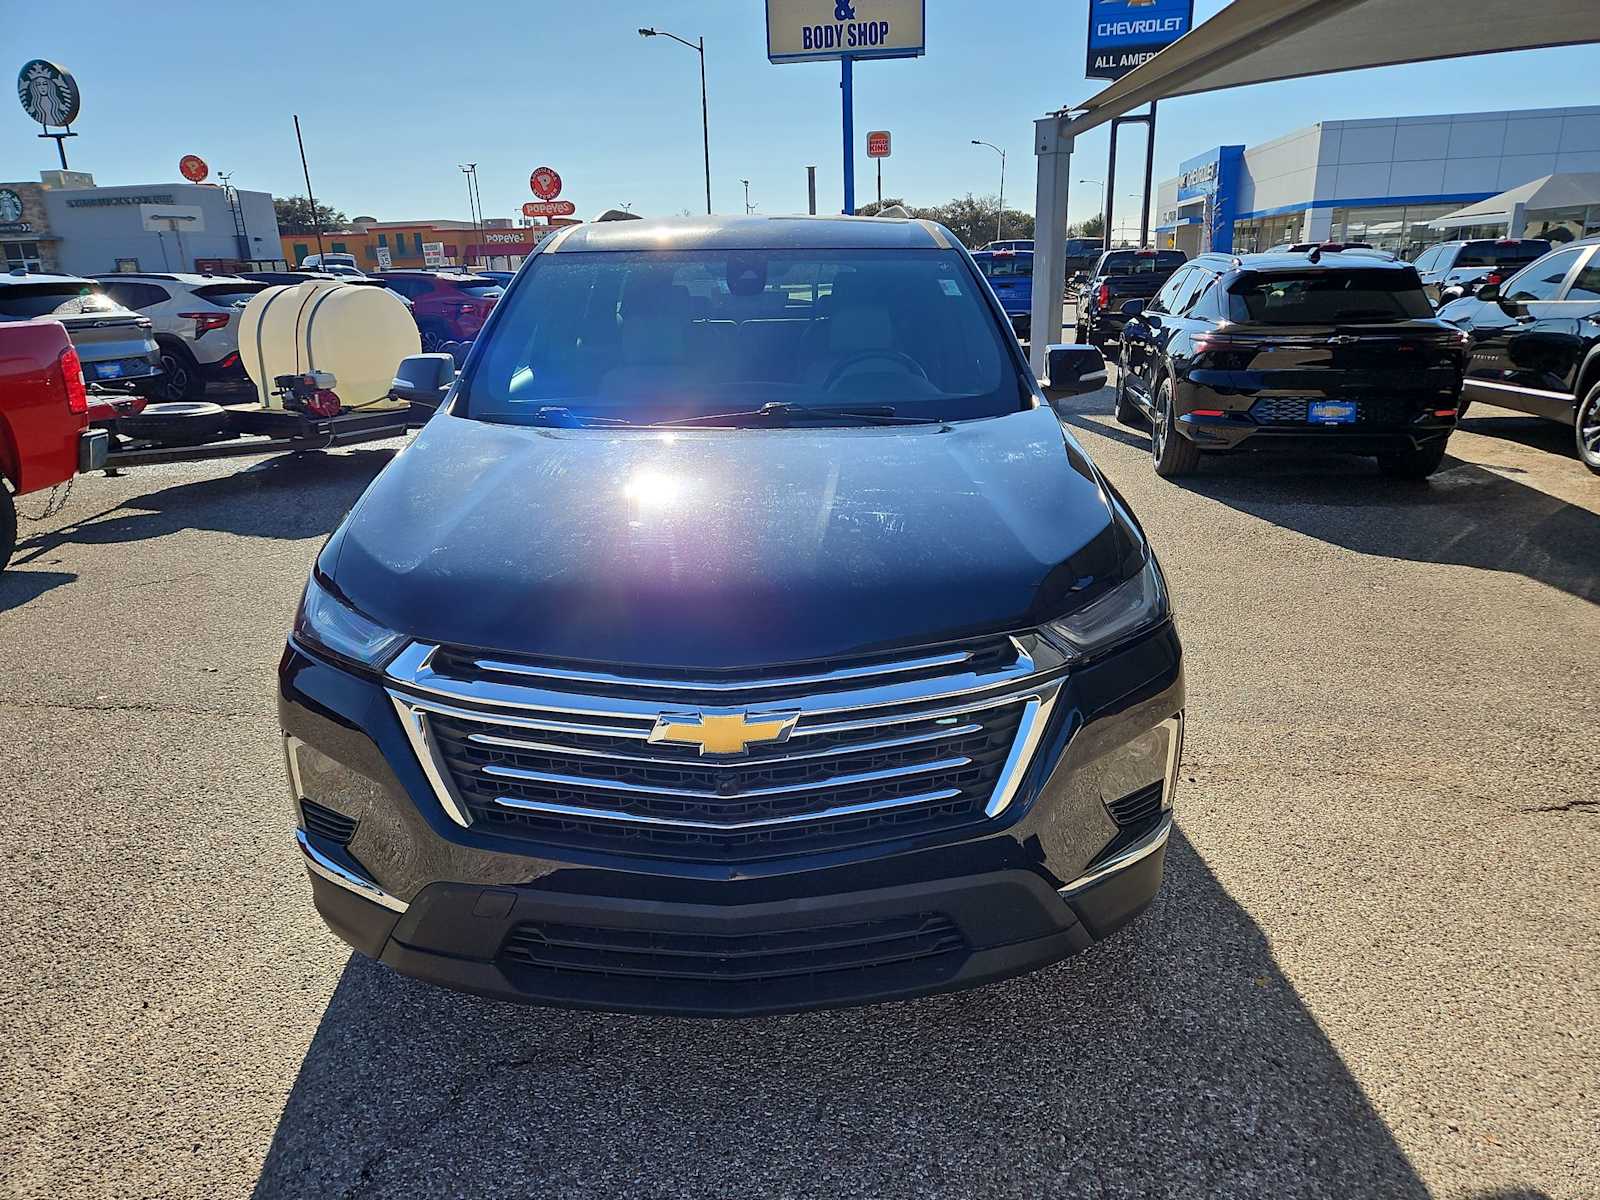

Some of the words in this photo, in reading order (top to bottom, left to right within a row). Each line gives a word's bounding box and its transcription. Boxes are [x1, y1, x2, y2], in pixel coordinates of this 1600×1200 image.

[802, 24, 843, 50] BODY
[848, 21, 889, 47] SHOP
[1097, 17, 1183, 37] CHEVROLET
[1095, 56, 1117, 69] ALL
[1119, 52, 1159, 67] AMER
[870, 144, 888, 152] KING
